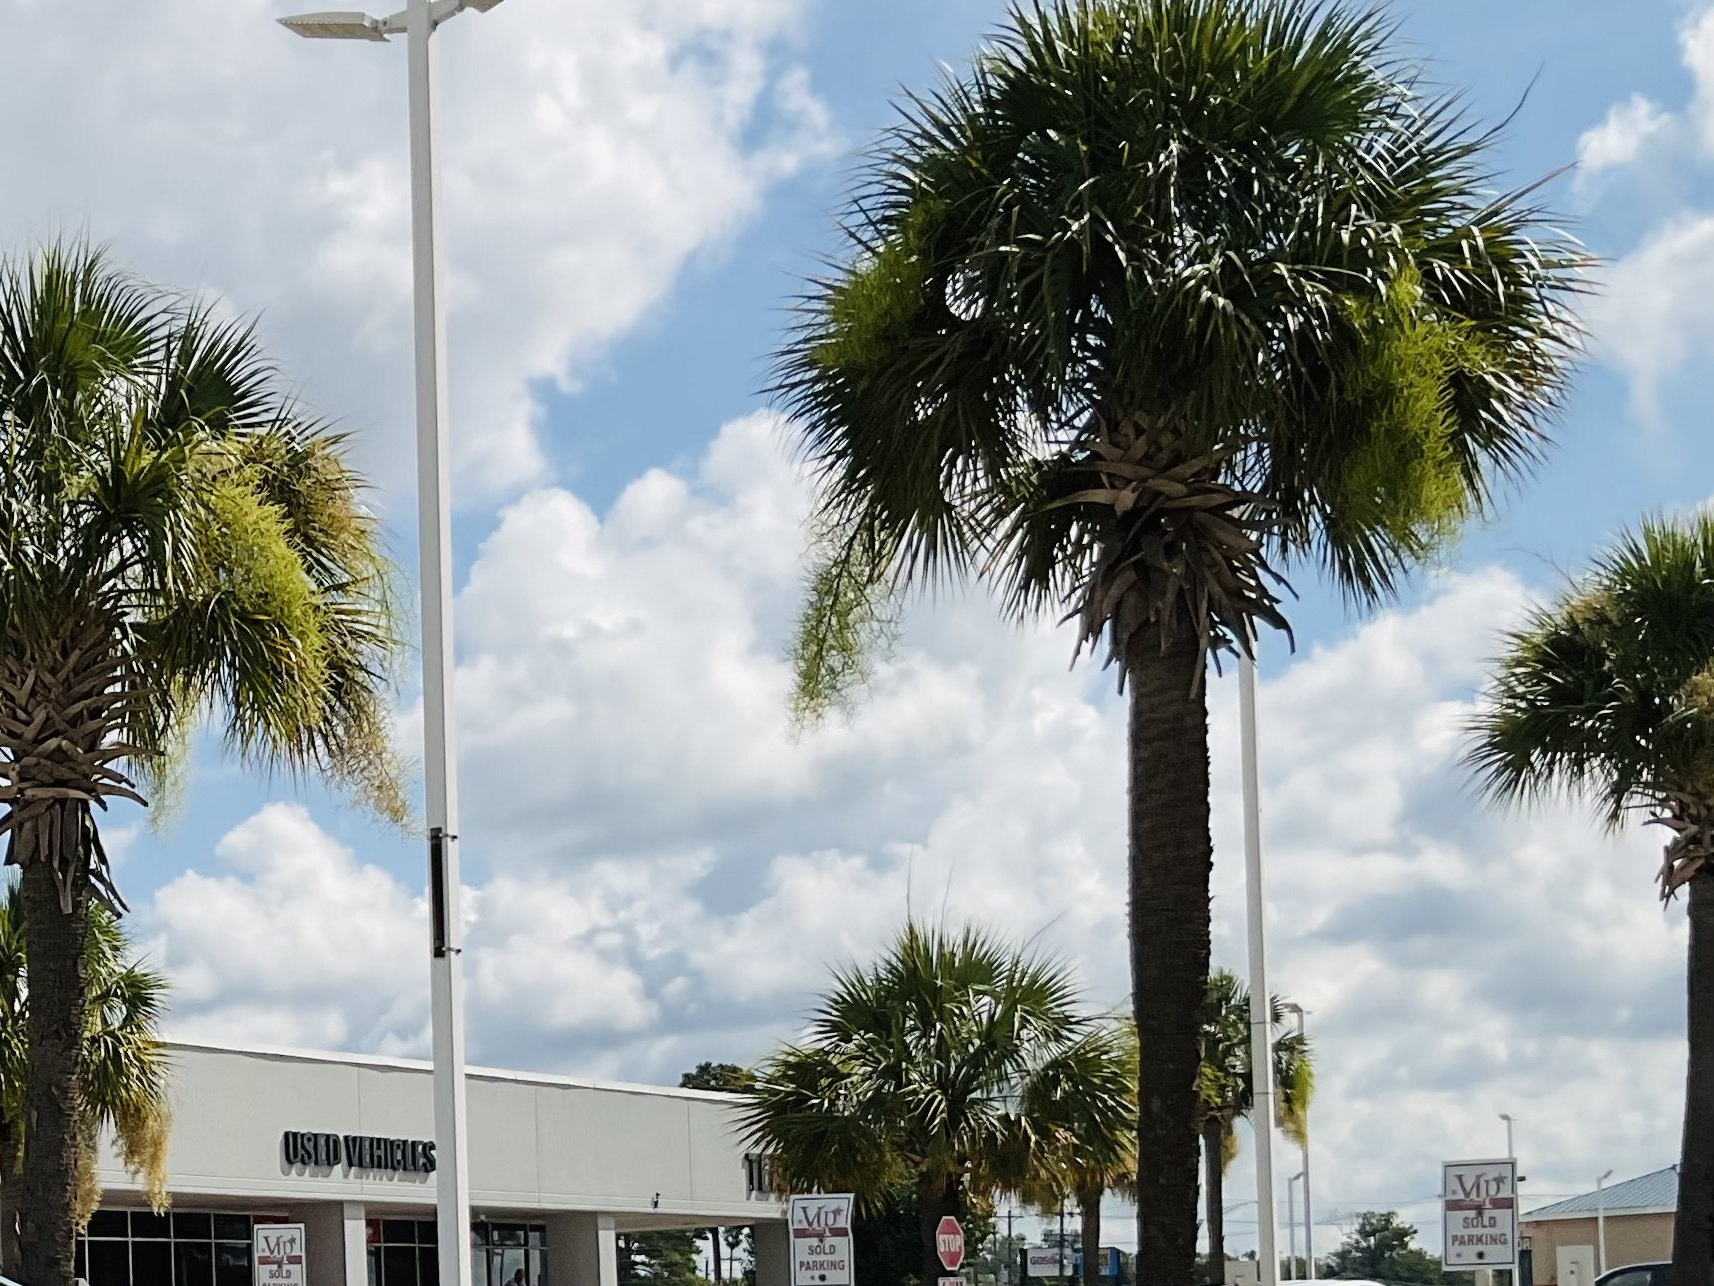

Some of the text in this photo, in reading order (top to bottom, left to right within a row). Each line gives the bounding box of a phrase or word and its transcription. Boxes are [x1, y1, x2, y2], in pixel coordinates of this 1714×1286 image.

[284, 1131, 436, 1172] USED VEHICLES
[1462, 1216, 1496, 1229] SOLD
[939, 1234, 961, 1252] STOP
[1451, 1233, 1508, 1246] PARKING
[808, 1244, 836, 1255] SOLD
[799, 1260, 845, 1271] PARKING
[268, 1269, 292, 1279] SOLD
